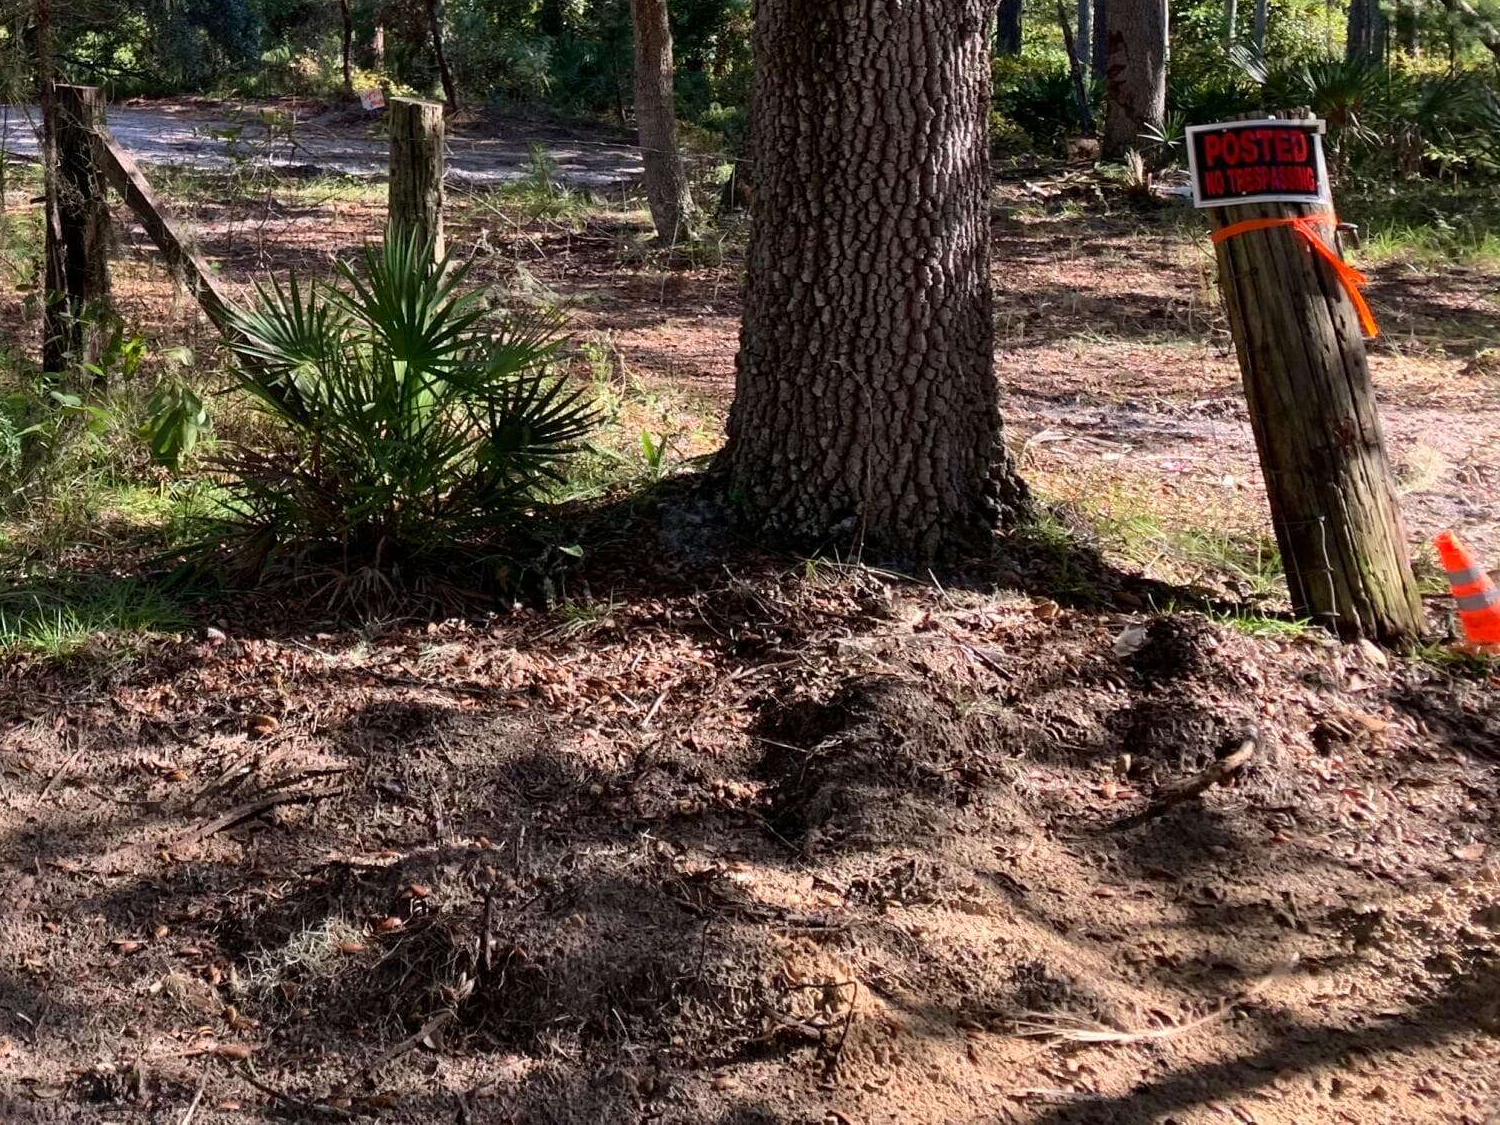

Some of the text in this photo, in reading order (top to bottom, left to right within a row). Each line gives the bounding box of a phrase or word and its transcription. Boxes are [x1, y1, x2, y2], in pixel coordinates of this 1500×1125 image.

[1204, 130, 1309, 166] POSTED
[1204, 165, 1316, 195] NO TRESPASSING
